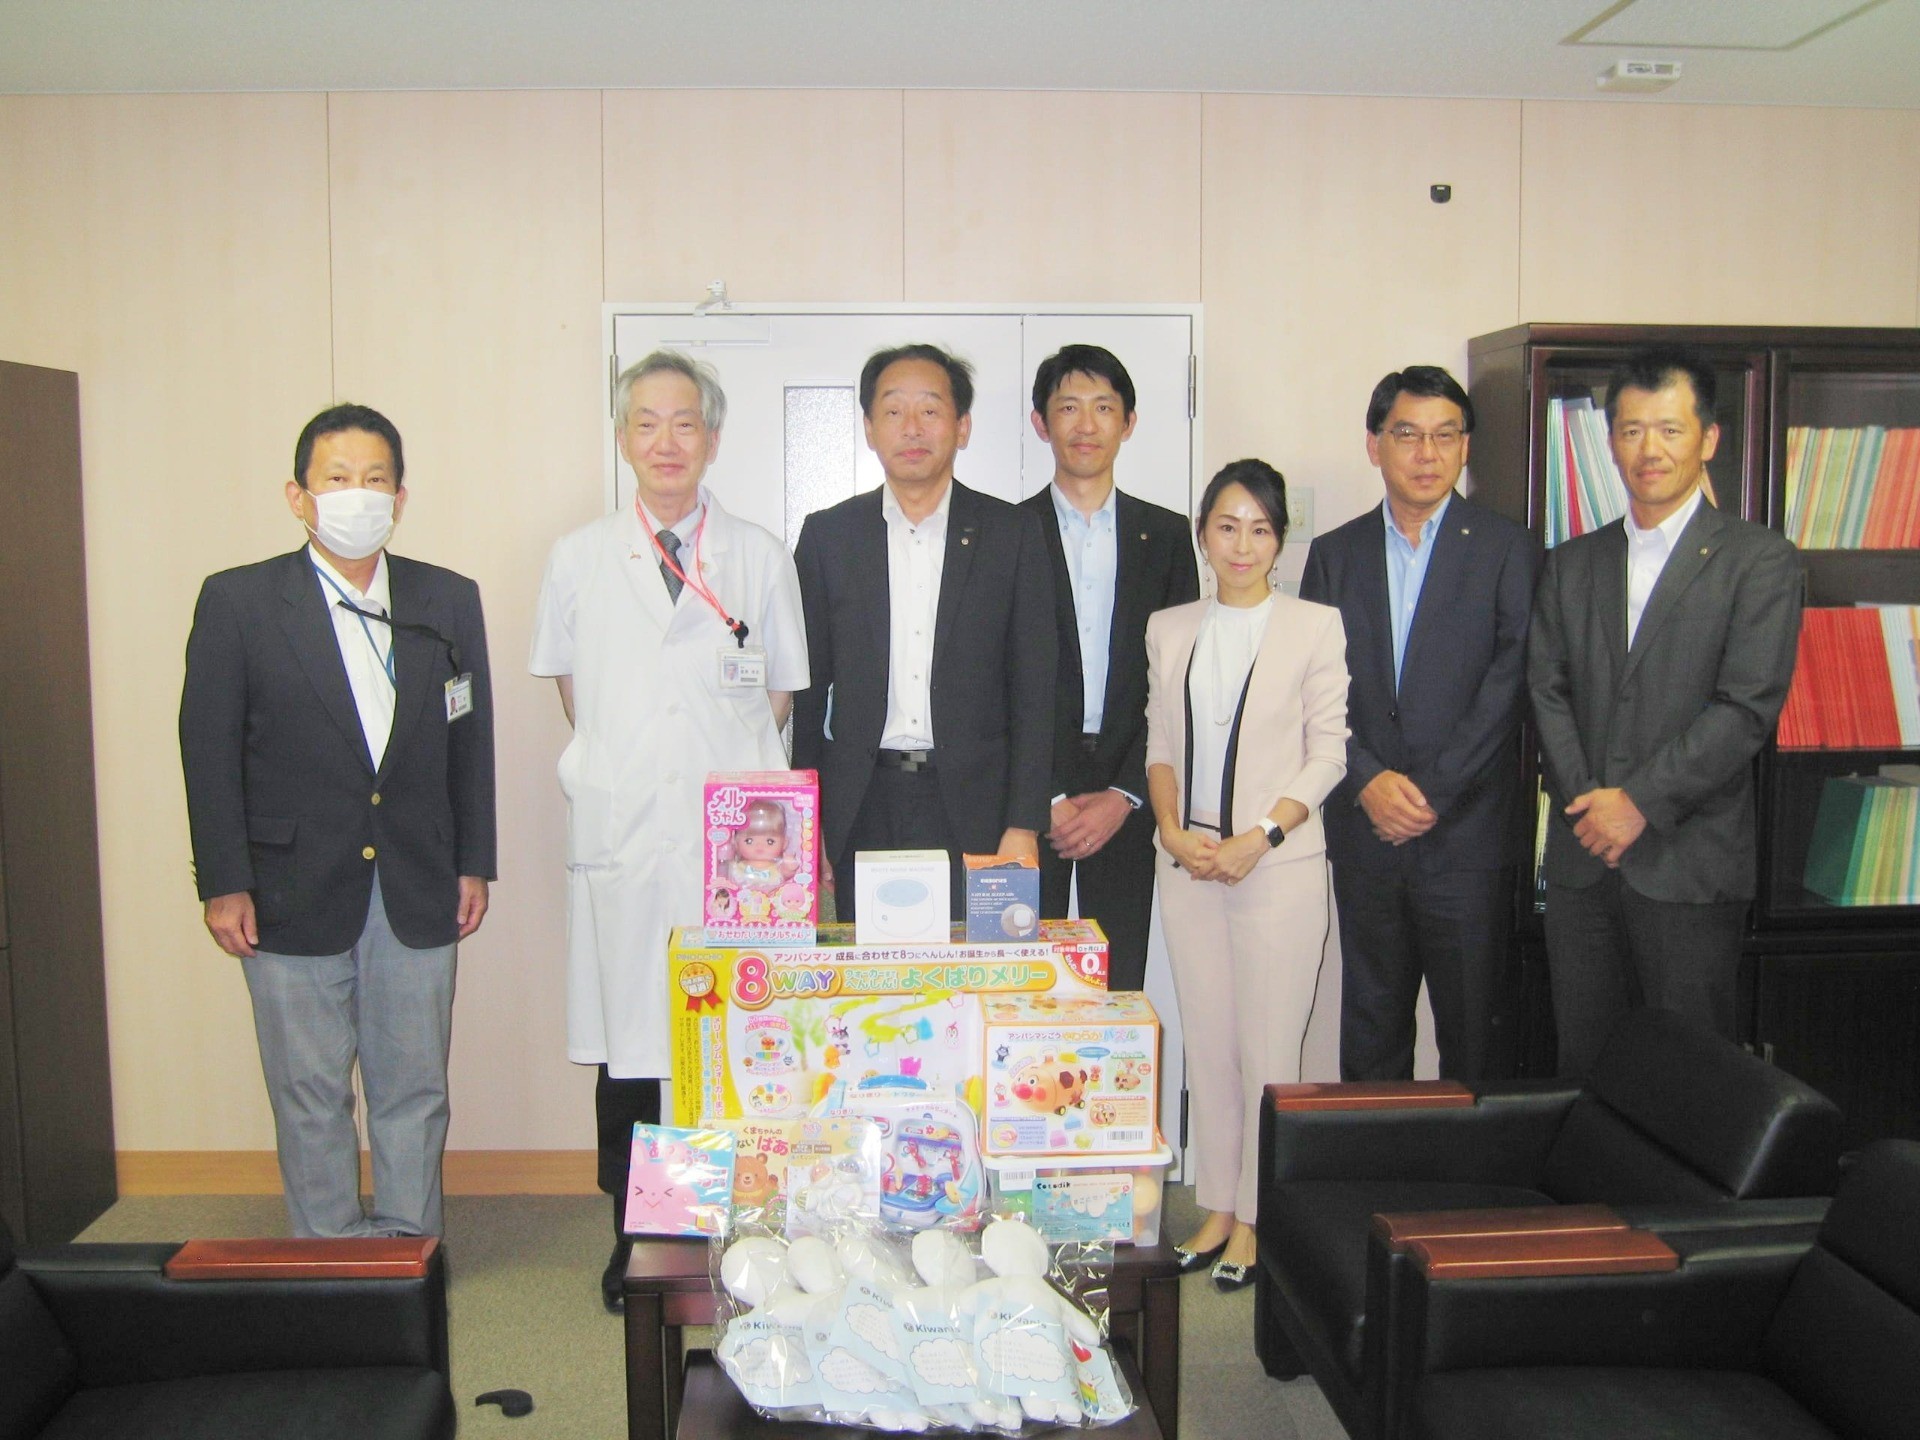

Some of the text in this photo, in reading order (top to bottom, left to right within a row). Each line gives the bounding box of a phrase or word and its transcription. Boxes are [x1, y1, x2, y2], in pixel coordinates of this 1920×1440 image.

[710, 789, 744, 809] メル
[710, 810, 744, 823] ちゃん
[773, 953, 831, 962] アンパンマン
[771, 968, 834, 992] WAY
[900, 965, 1048, 989] よくばりメリー
[743, 1126, 783, 1135] くまちゃんの
[757, 1136, 789, 1156] ばあ
[915, 1324, 961, 1333] Kiwanis
